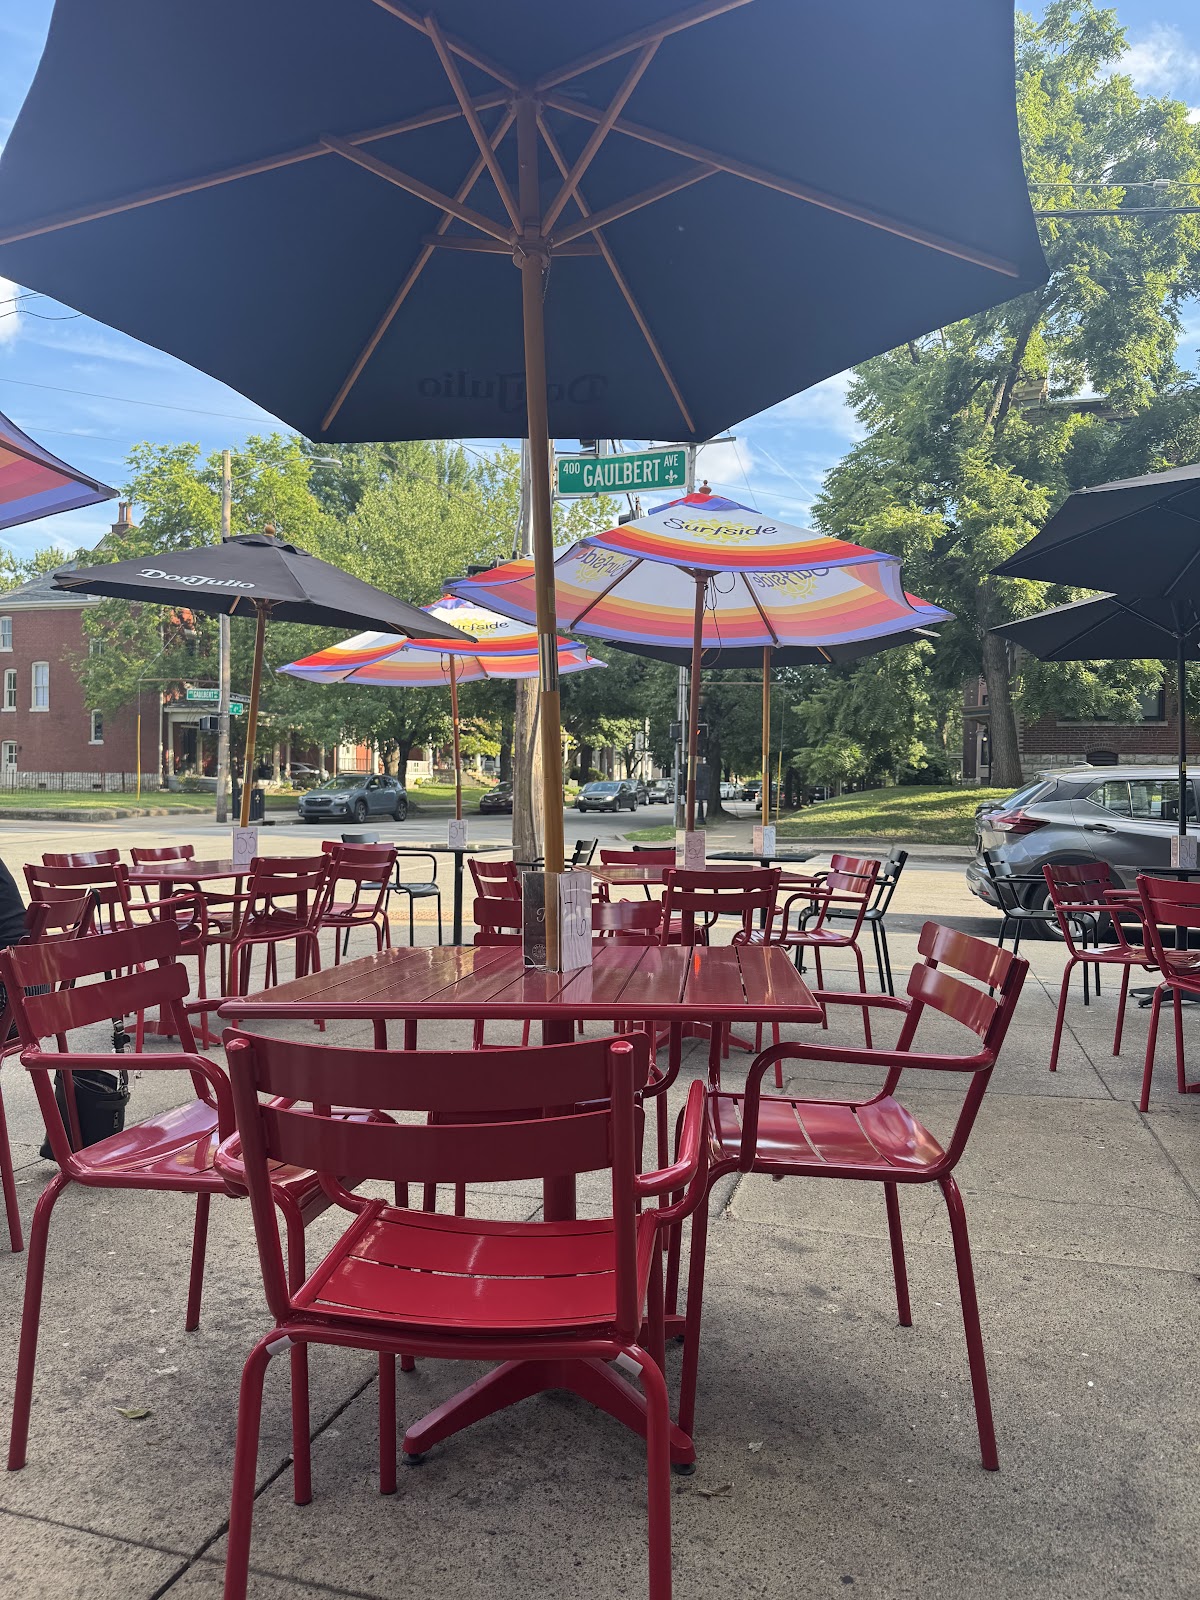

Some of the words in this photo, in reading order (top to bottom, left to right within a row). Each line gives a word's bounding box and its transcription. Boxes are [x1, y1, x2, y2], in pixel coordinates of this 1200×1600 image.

[562, 462, 580, 475] 400
[583, 459, 661, 487] GAULBERT
[663, 454, 679, 467] AVE
[663, 517, 778, 536] Surfside
[450, 821, 465, 840] 54
[236, 831, 256, 855] 53
[562, 880, 587, 939] 46
